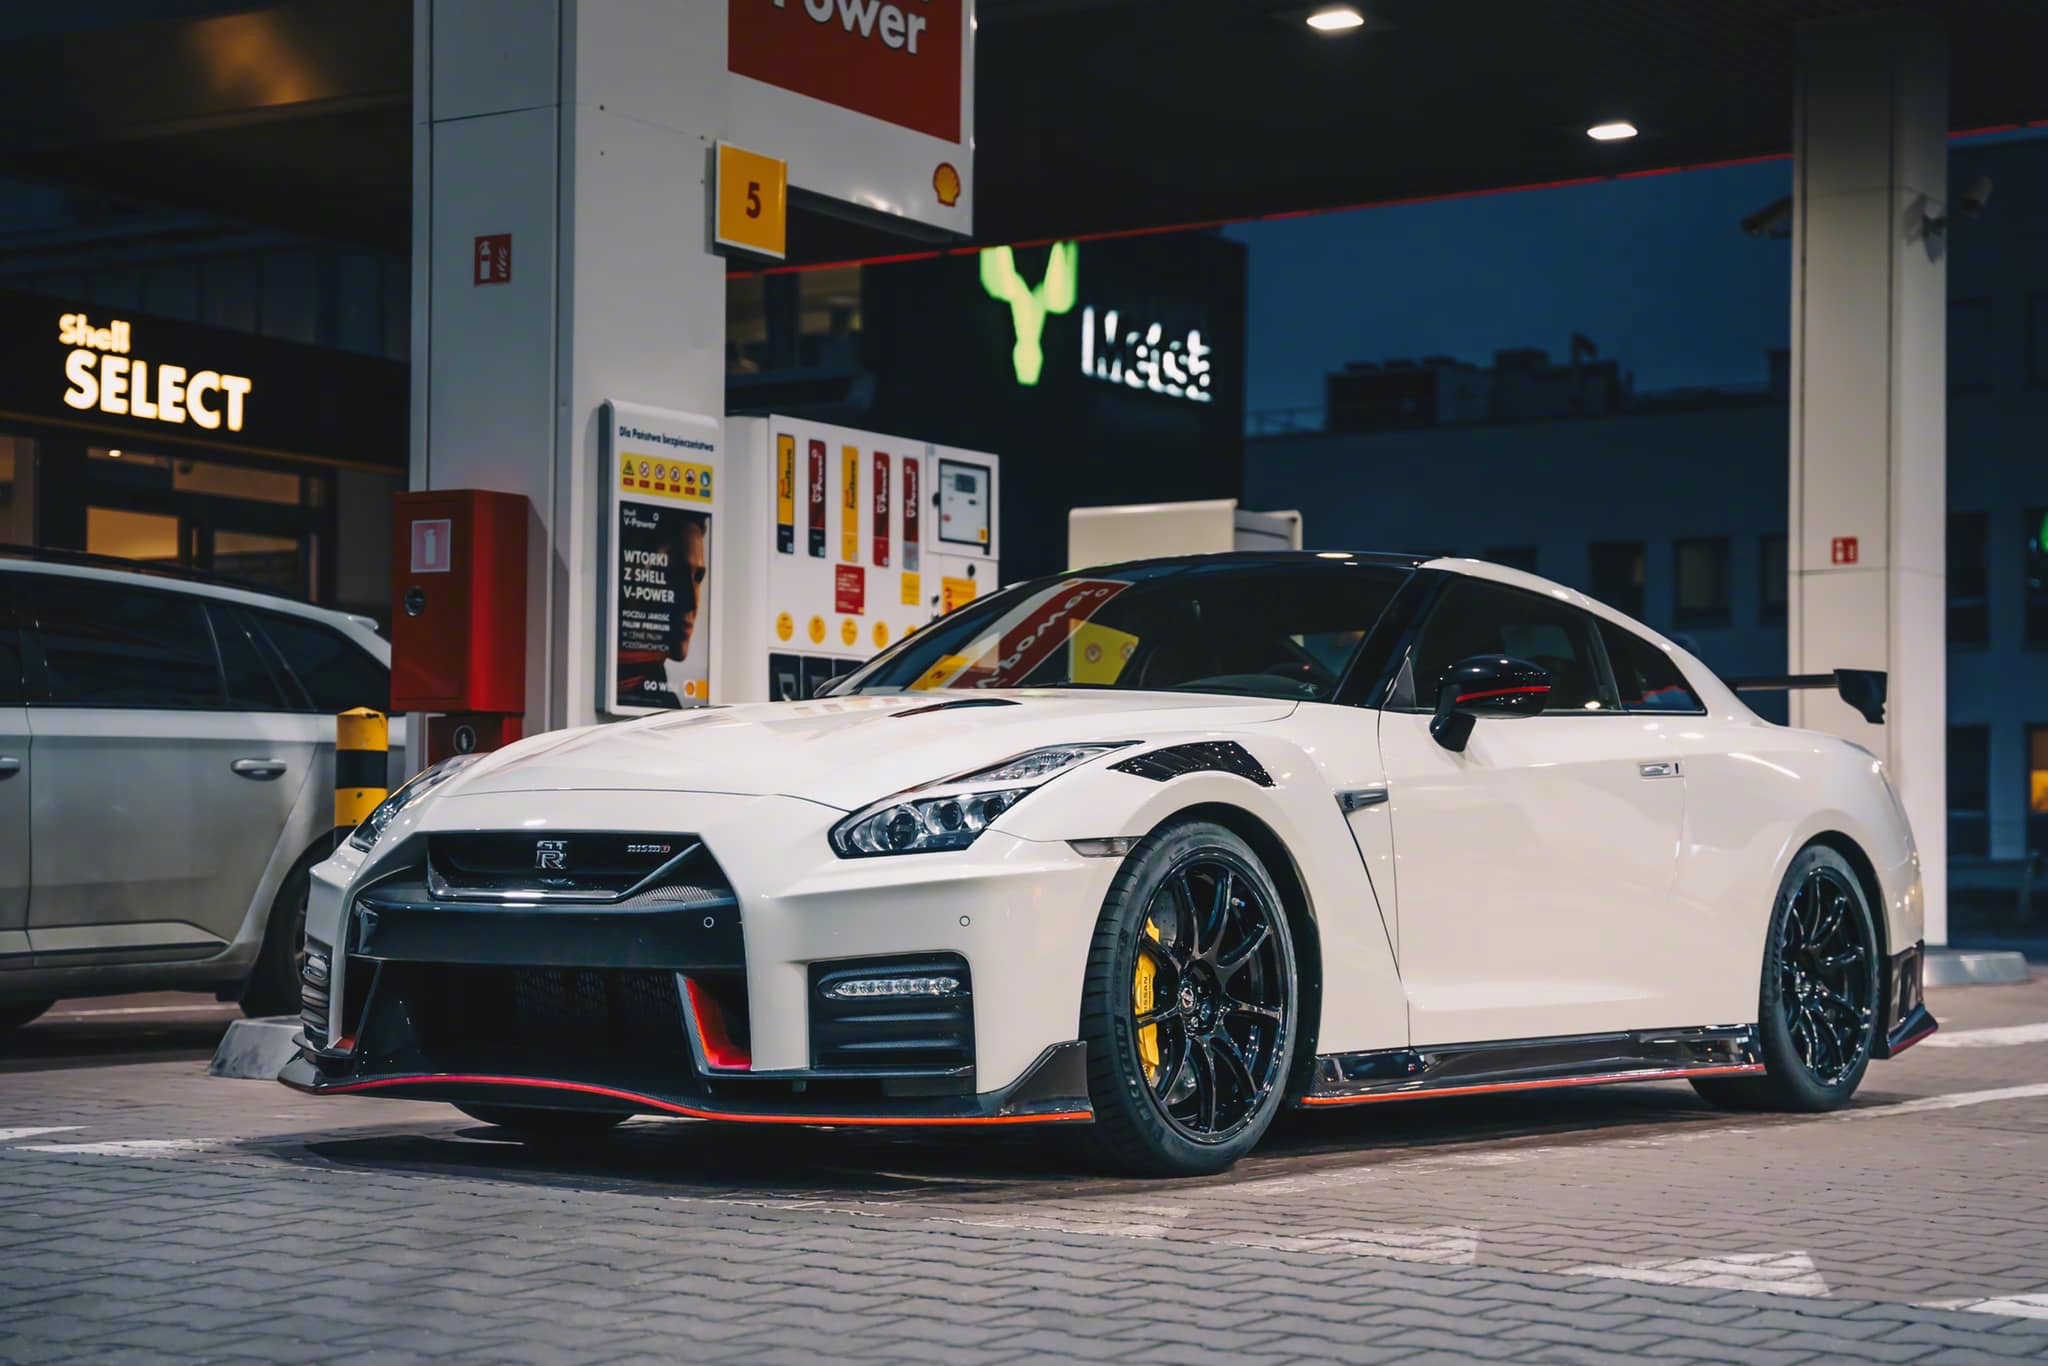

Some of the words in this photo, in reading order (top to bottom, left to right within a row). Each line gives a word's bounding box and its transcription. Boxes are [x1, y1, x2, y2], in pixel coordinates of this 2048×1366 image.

[770, 0, 927, 54] ower
[745, 181, 762, 219] 5
[58, 312, 131, 353] Shell
[63, 348, 252, 432] SELECT
[624, 517, 657, 529] V-Power
[624, 550, 669, 567] WTORKI
[624, 568, 632, 581] Z
[635, 568, 667, 585] SHELL
[623, 586, 675, 603] V-POWER
[643, 680, 658, 691] GO
